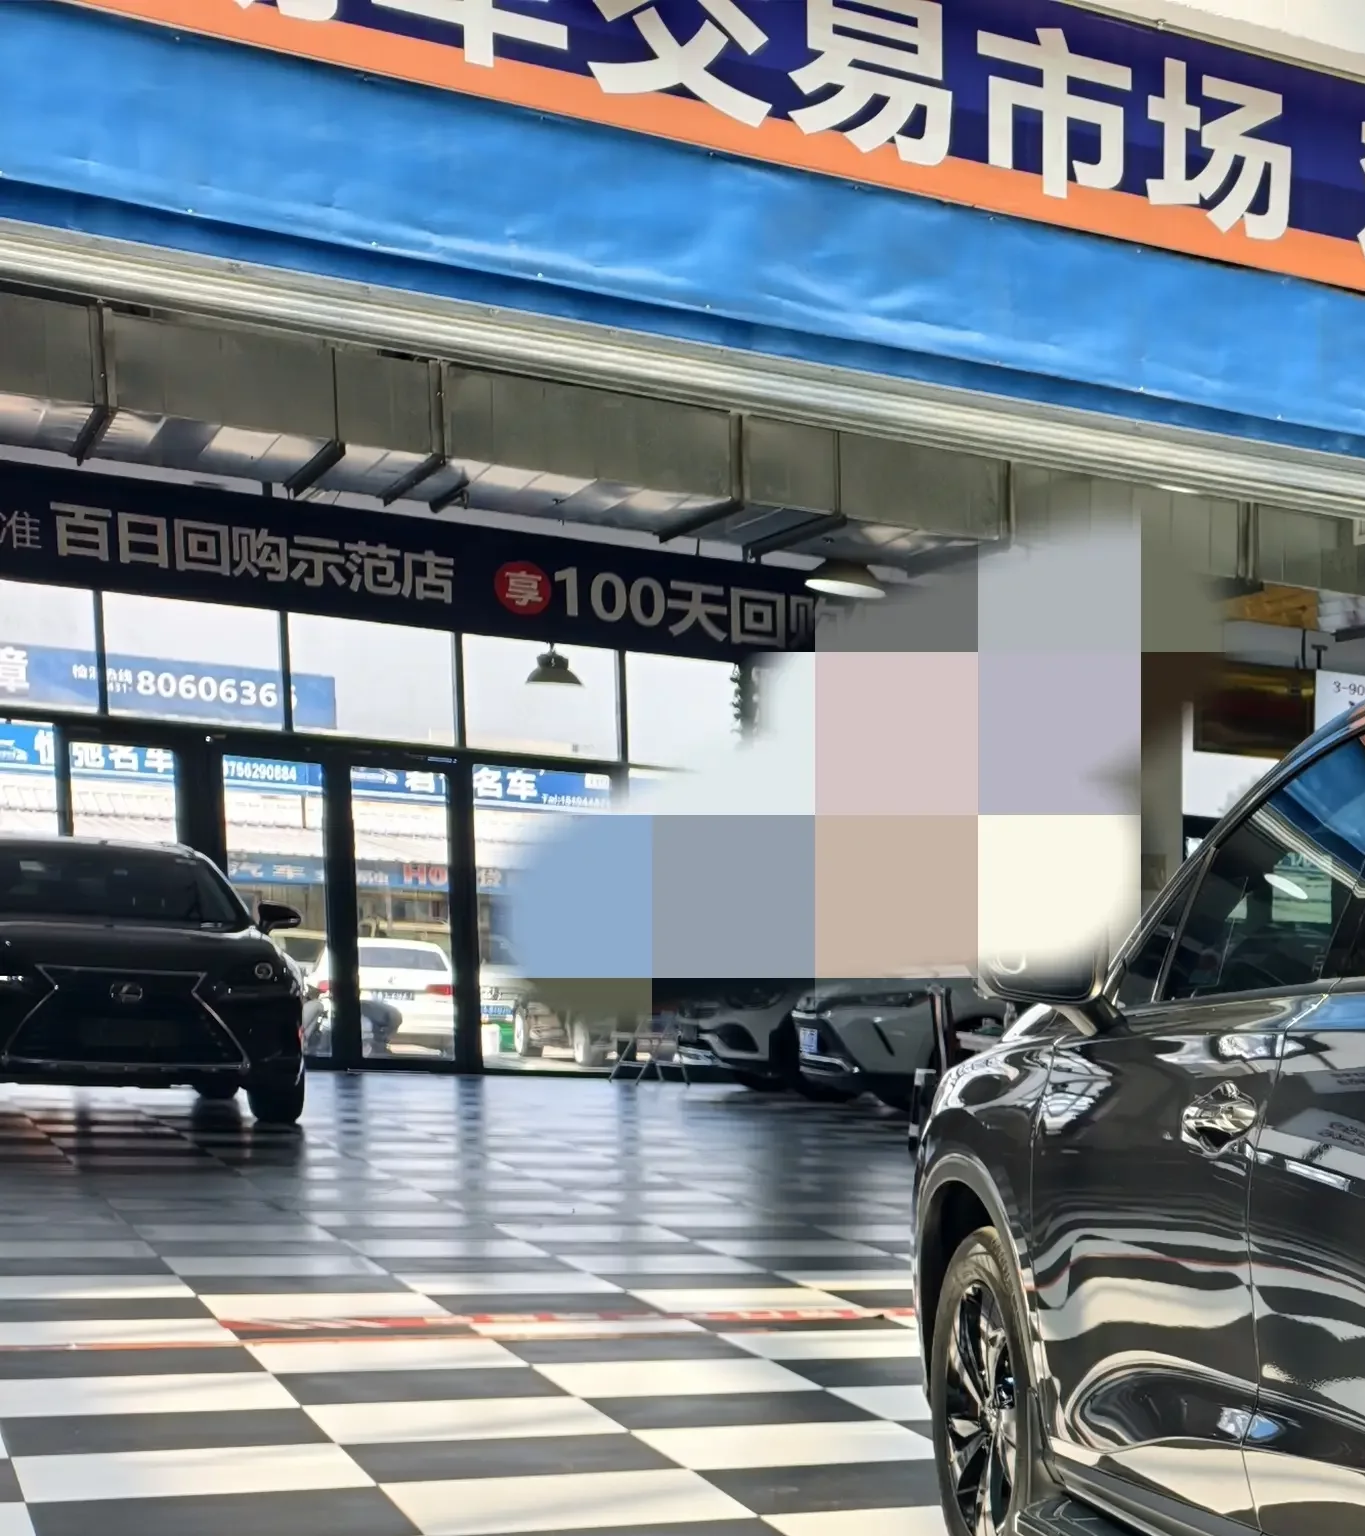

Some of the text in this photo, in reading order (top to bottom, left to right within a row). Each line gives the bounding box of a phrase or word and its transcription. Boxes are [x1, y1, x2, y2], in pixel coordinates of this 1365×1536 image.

[232, 0, 1292, 240] 交易市场
[49, 501, 455, 604] 百日回购示范店
[504, 570, 544, 607] 享
